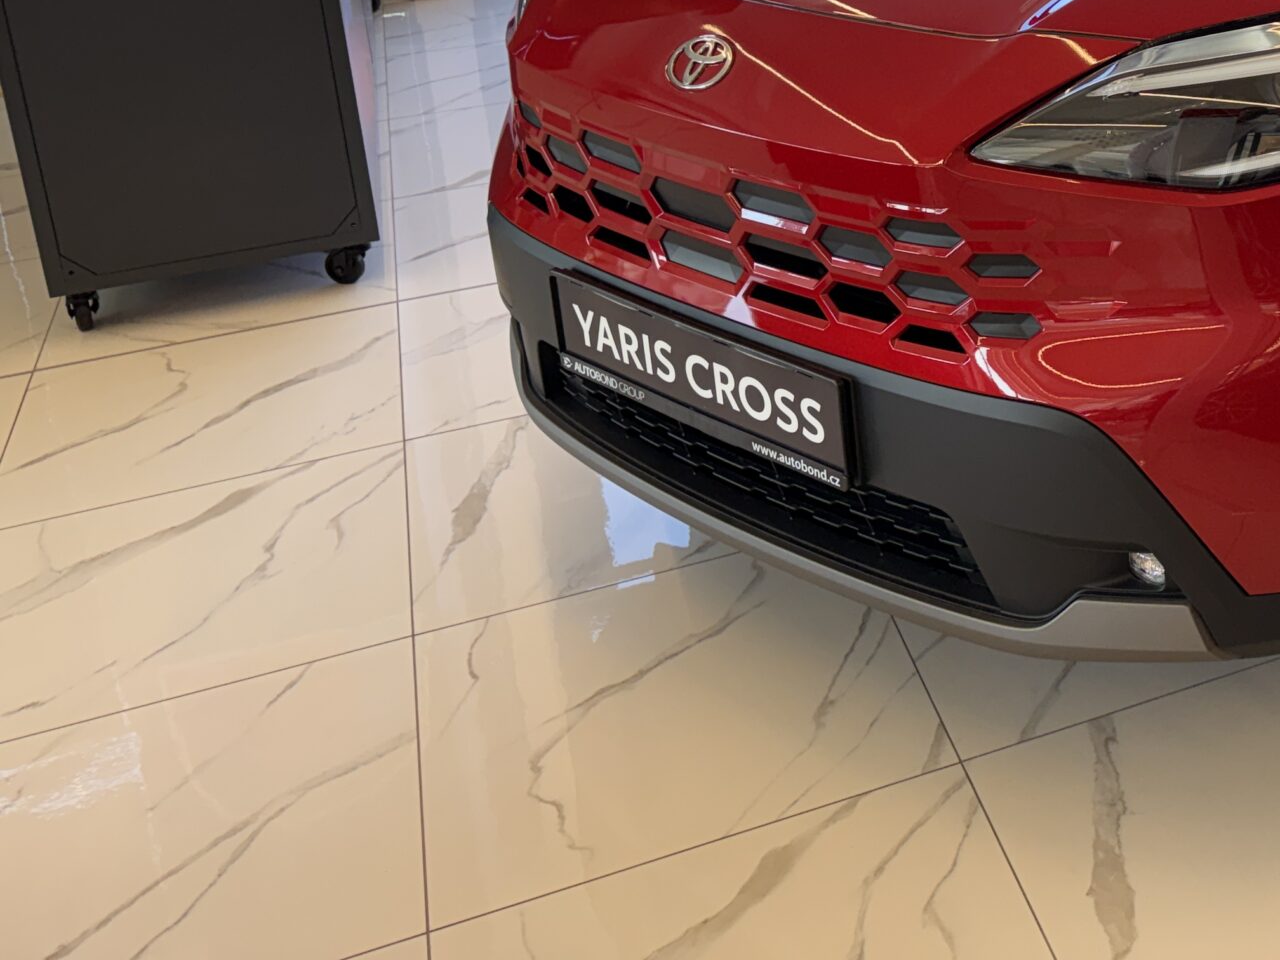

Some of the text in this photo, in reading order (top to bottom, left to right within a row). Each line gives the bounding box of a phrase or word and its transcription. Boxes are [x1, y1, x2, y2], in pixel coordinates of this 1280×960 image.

[571, 303, 826, 444] YARIS CROSS
[574, 361, 645, 401] AUTOBOND GROUP
[751, 440, 841, 488] www.autobond.cz
